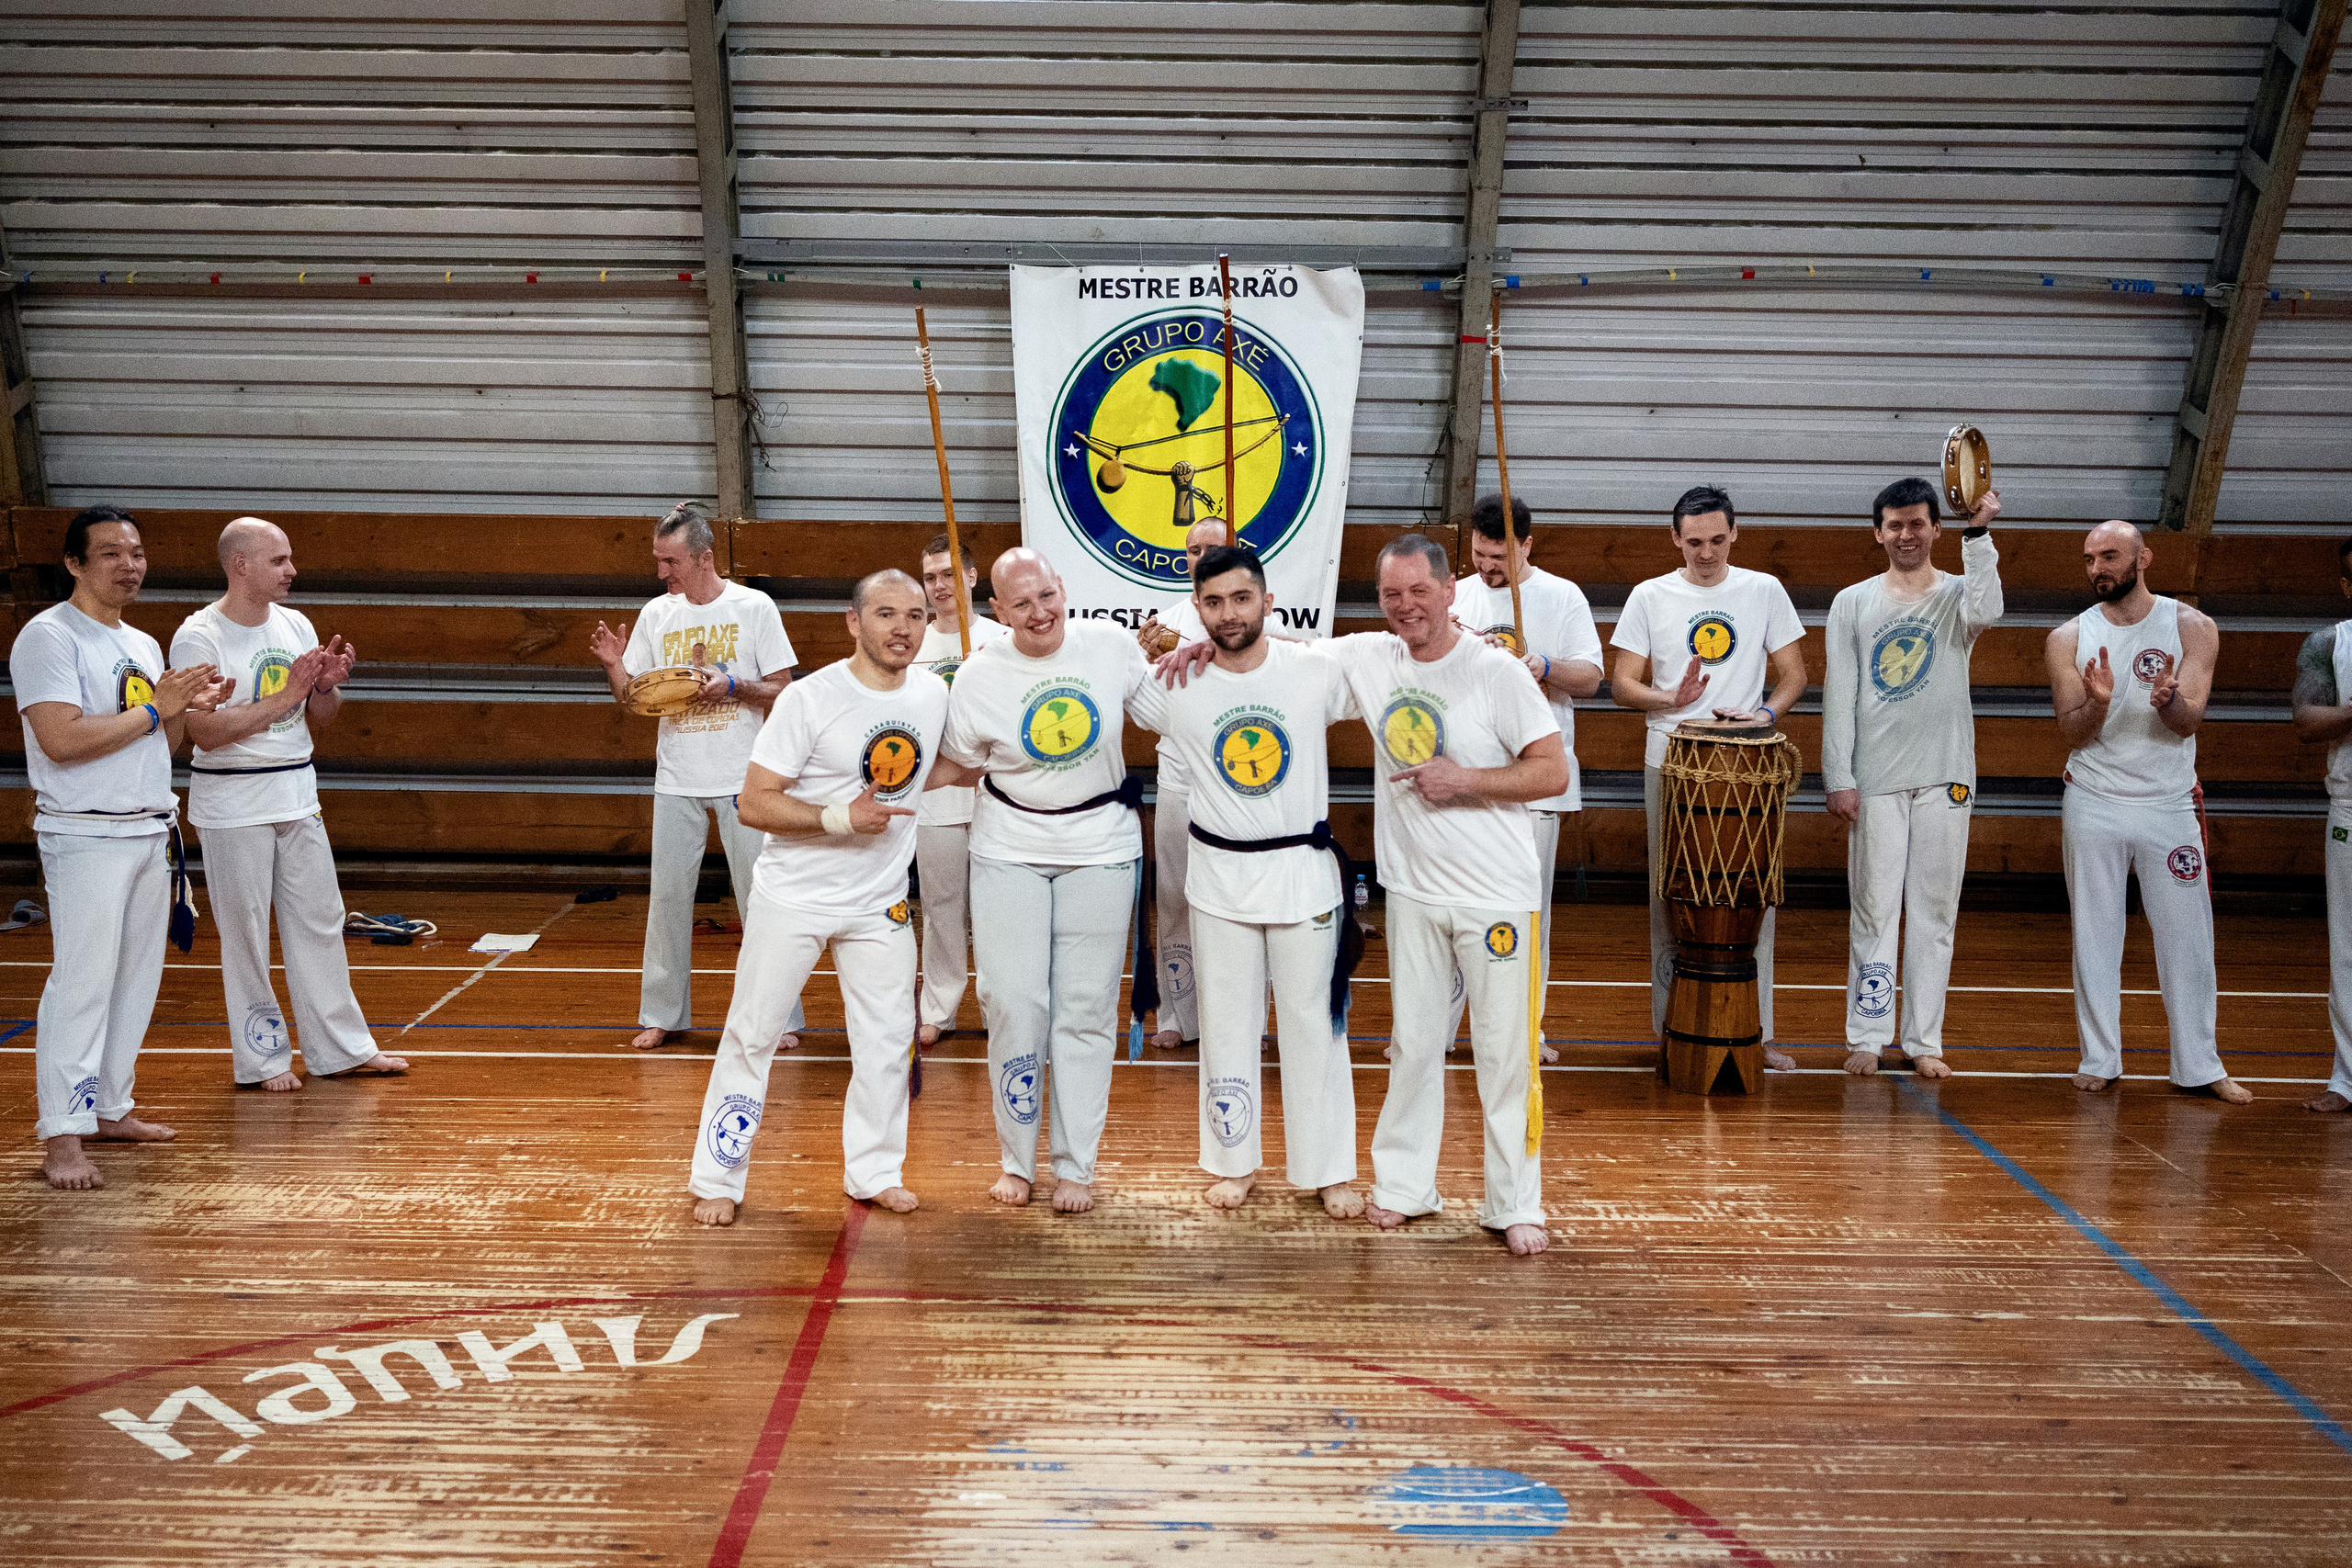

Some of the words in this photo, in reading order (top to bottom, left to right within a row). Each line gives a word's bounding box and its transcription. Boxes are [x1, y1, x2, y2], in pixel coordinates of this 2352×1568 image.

[1079, 277, 1180, 299] MESTRE
[1189, 268, 1298, 298] BARRÃO
[1103, 321, 1204, 371] GRUPO
[1688, 611, 1710, 625] MESTRE
[663, 626, 705, 650] GRUPO
[708, 623, 739, 642] AXE
[1872, 618, 1905, 638] MESTRE
[1881, 628, 1912, 646] GRUPO
[1021, 679, 1053, 705] MESTRE
[1916, 680, 1930, 693] YAN
[1031, 689, 1062, 711] GRUPO
[1213, 705, 1247, 728] MESTRE
[1250, 705, 1285, 722] BARRÃO
[708, 722, 729, 731] 2021
[1224, 717, 1255, 736] GRUPO
[1084, 748, 1100, 762] YAN
[724, 1093, 748, 1101] MESTRE
[729, 1104, 751, 1112] GRUPO
